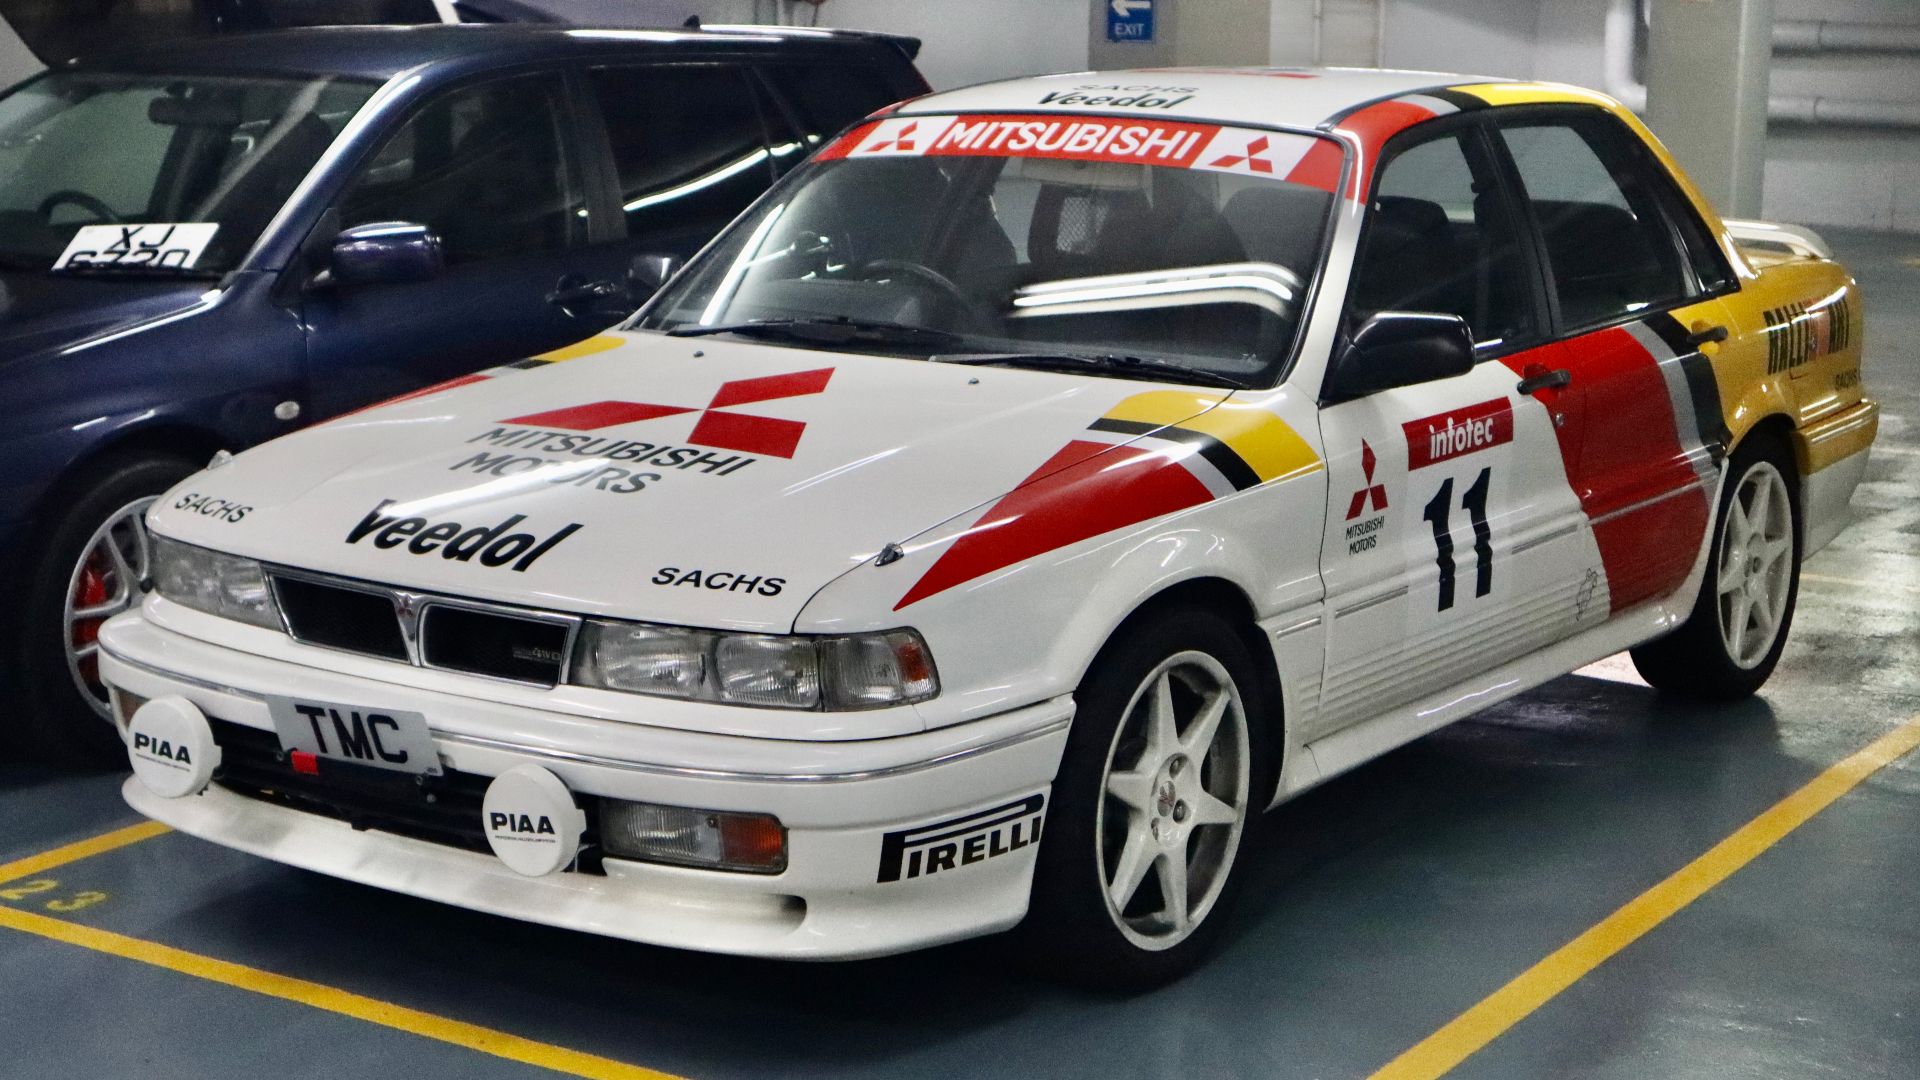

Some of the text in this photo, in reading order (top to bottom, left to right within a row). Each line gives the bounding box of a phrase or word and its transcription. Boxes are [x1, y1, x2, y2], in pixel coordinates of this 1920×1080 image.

[1115, 22, 1144, 36] EXIT
[1038, 91, 1195, 109] Veedol
[1073, 84, 1199, 93] SACHS
[936, 121, 1202, 160] MITSUBISHI
[109, 226, 176, 249] XJ
[465, 427, 757, 476] MITSUBISHI
[1429, 417, 1494, 460] infotec
[174, 493, 253, 523] SACHS
[345, 498, 585, 572] Veedol
[1345, 515, 1385, 541] MITSUBISHI
[1423, 466, 1493, 612] 11
[1349, 535, 1377, 556] MOTORS
[651, 567, 787, 597] SACHS
[134, 732, 192, 766] PIAA
[294, 704, 409, 764] TMC
[490, 812, 556, 835] PIAA
[876, 793, 1045, 883] PIRELLI
